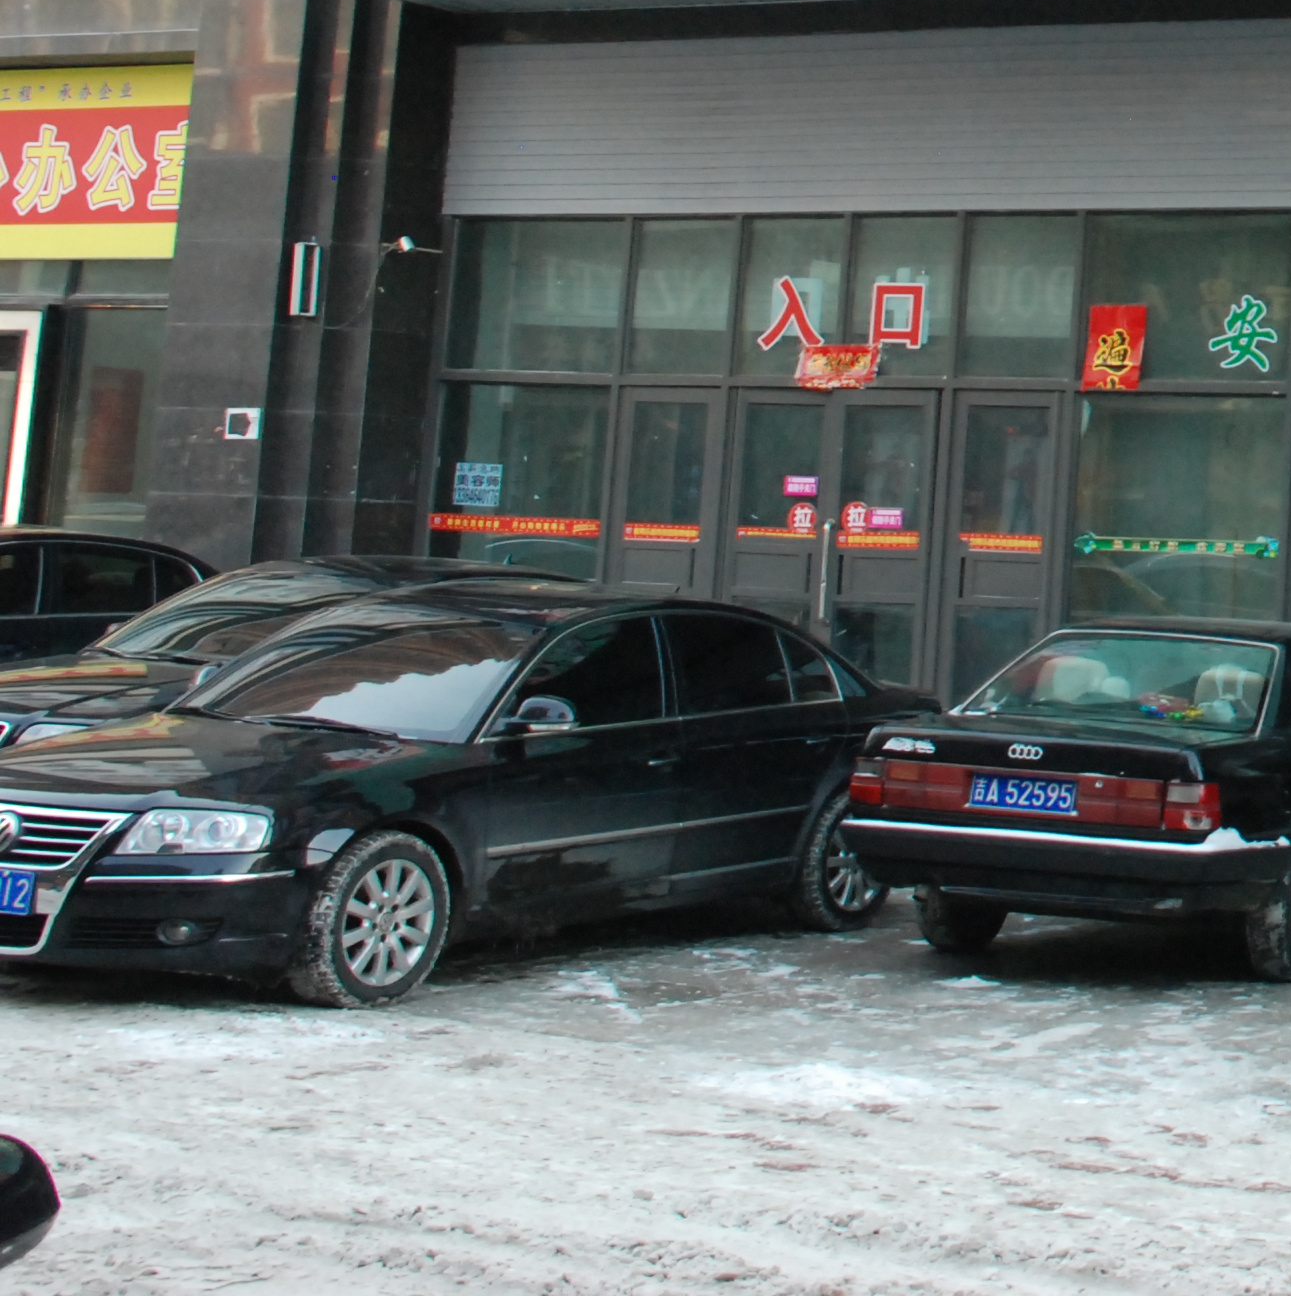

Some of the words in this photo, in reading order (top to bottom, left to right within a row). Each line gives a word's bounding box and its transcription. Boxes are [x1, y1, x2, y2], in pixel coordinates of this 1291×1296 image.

[0, 122, 189, 216] 办公室
[757, 275, 926, 350] 入口
[793, 506, 813, 528] 拉
[847, 505, 867, 527] 拉
[0, 875, 29, 908] 12
